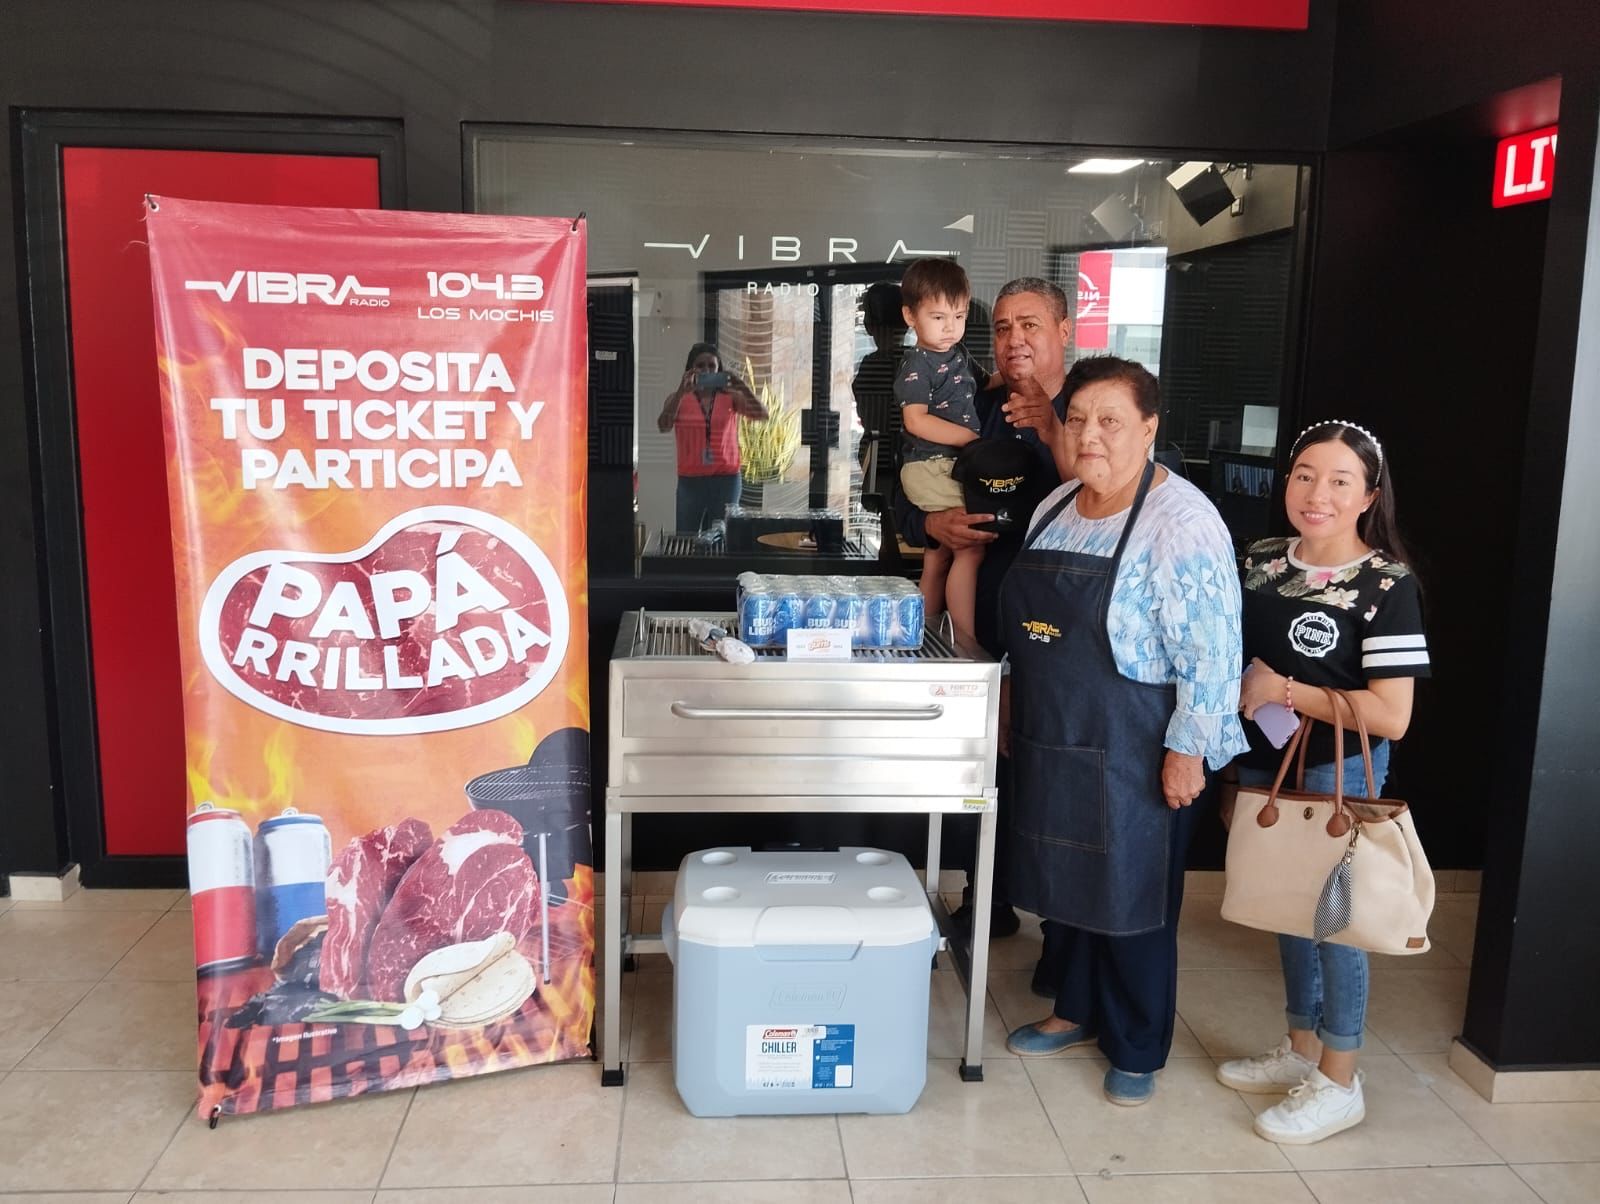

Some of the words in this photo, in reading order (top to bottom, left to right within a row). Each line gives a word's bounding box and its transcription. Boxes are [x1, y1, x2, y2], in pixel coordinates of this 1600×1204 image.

[644, 234, 960, 263] VIBRA
[185, 271, 390, 304] VIBRA
[426, 271, 544, 300] 104.3
[747, 281, 820, 297] RADIO
[349, 298, 390, 307] RADIO
[417, 306, 461, 320] LOS
[469, 308, 555, 322] MOCHIS
[242, 346, 516, 393] DEPOSITA
[210, 397, 286, 441] TU
[303, 398, 497, 441] TICKET
[506, 400, 545, 441] Y
[241, 447, 523, 490] PARTICIPA
[248, 528, 511, 641] PAPÁ
[807, 618, 831, 627] BUD
[1022, 620, 1060, 635] VIBRA
[1294, 624, 1333, 645] PINK
[231, 607, 552, 691] RRILLADA
[761, 1041, 797, 1053] CHILLER
